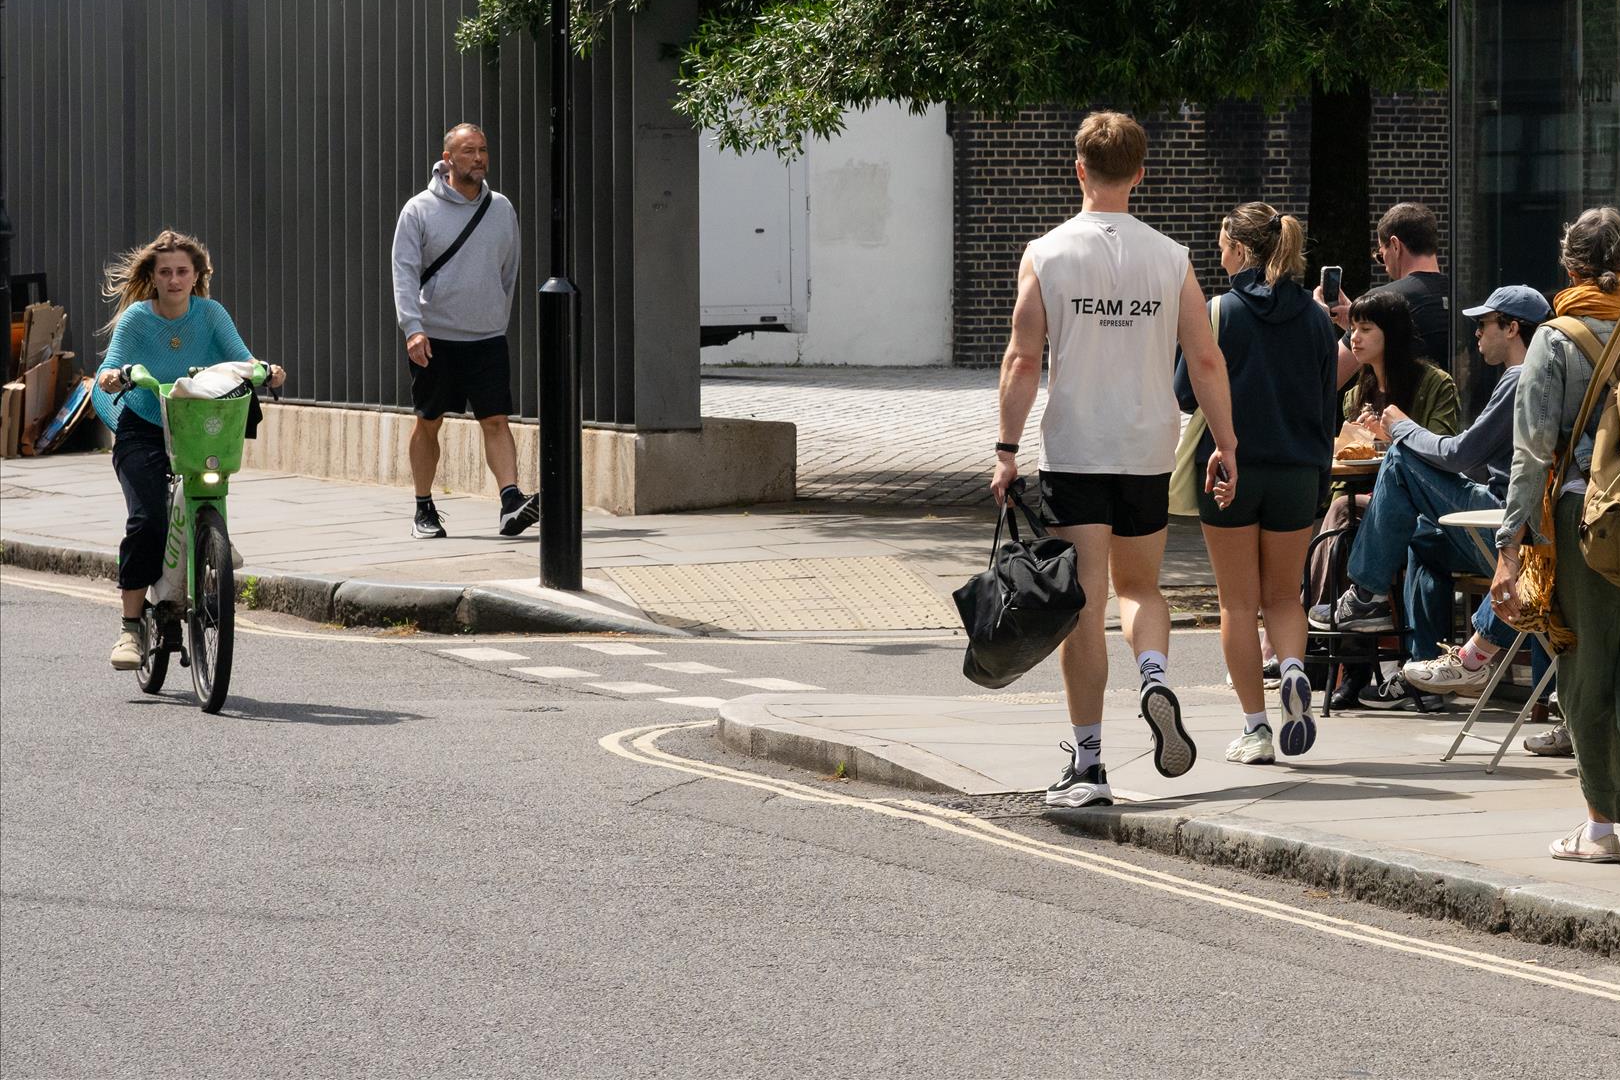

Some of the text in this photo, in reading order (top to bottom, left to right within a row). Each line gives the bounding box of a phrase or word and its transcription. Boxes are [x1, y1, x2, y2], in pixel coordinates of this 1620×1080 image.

[1071, 298, 1162, 317] TEAM 247
[1099, 319, 1134, 327] REPRESENT
